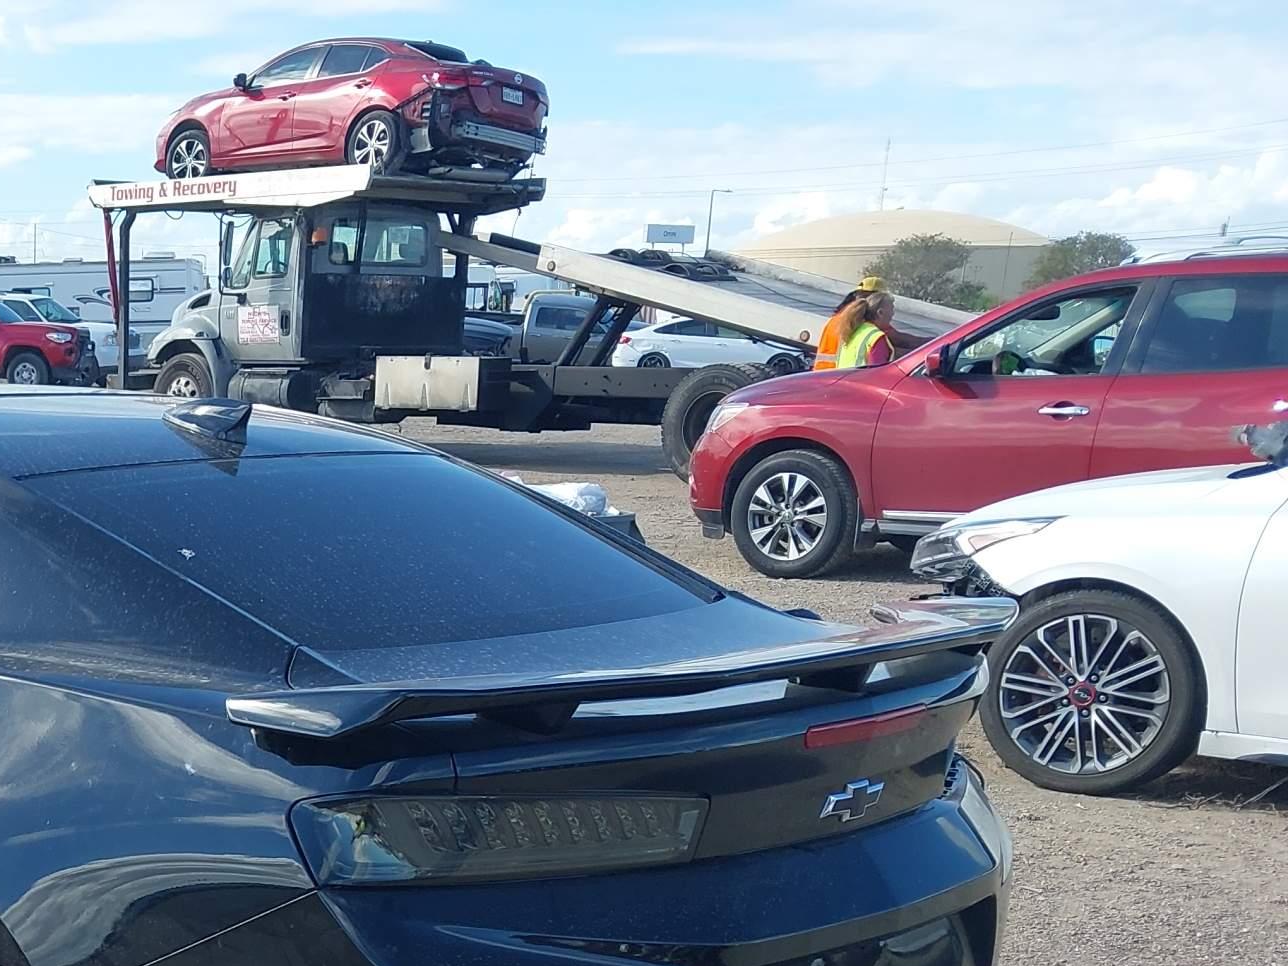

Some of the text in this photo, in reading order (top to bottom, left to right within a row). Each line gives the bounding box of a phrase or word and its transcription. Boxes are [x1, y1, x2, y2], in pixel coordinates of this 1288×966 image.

[110, 180, 237, 203] Towing & Recovery
